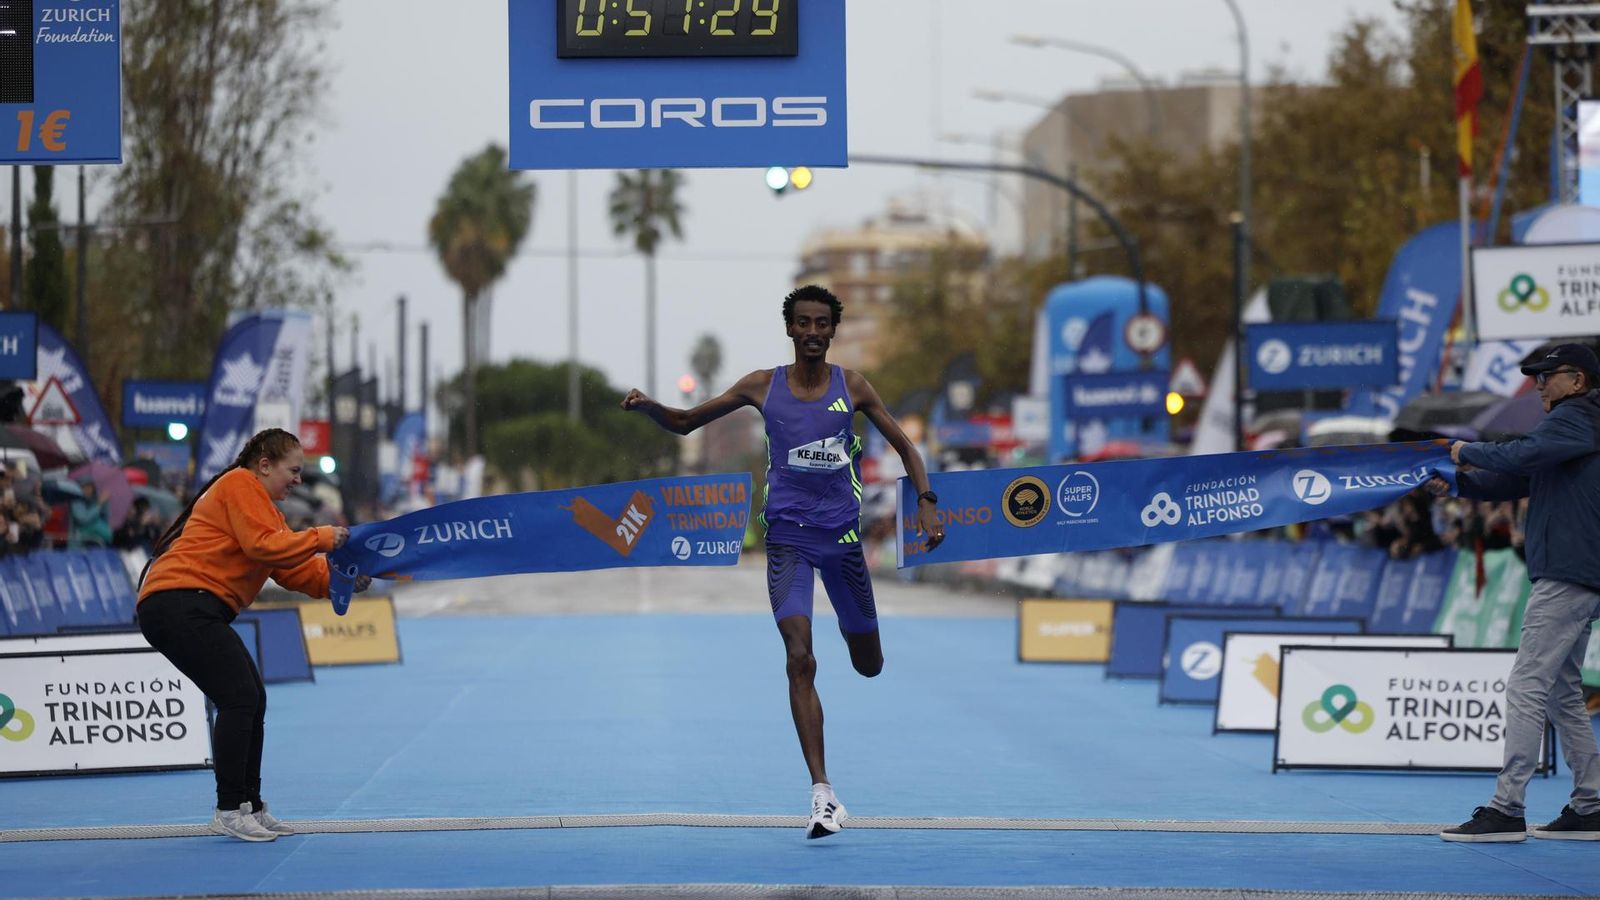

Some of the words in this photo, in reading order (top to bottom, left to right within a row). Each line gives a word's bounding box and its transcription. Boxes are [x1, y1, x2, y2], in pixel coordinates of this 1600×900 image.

[41, 8, 110, 23] ZURICH
[36, 26, 116, 44] Foundation
[529, 96, 827, 129] COROS
[1560, 300, 1600, 316] ALF
[1299, 345, 1383, 367] ZURICH
[821, 440, 826, 448] 1
[1185, 475, 1256, 493] FUNDACIÓN
[1338, 466, 1428, 490] ZURICH
[661, 482, 747, 507] VALENCIA
[1064, 485, 1092, 495] SUPER
[1064, 493, 1092, 502] HALFS
[1185, 488, 1260, 510] TRINIDAD
[616, 504, 648, 547] 21K
[667, 511, 747, 531] TRINIDAD
[903, 506, 992, 529] ALONSO
[1187, 503, 1264, 527] ALFONSO
[414, 519, 513, 544] ZURICH
[697, 540, 742, 555] ZURICH
[45, 678, 182, 697] FUNDACIÓN
[1388, 677, 1506, 693] FUNDACIÓ
[45, 698, 185, 725] TRINIDAD
[1387, 697, 1502, 719] TRINIDA
[48, 721, 187, 746] ALFONSO
[1386, 722, 1507, 742] ALFONS
